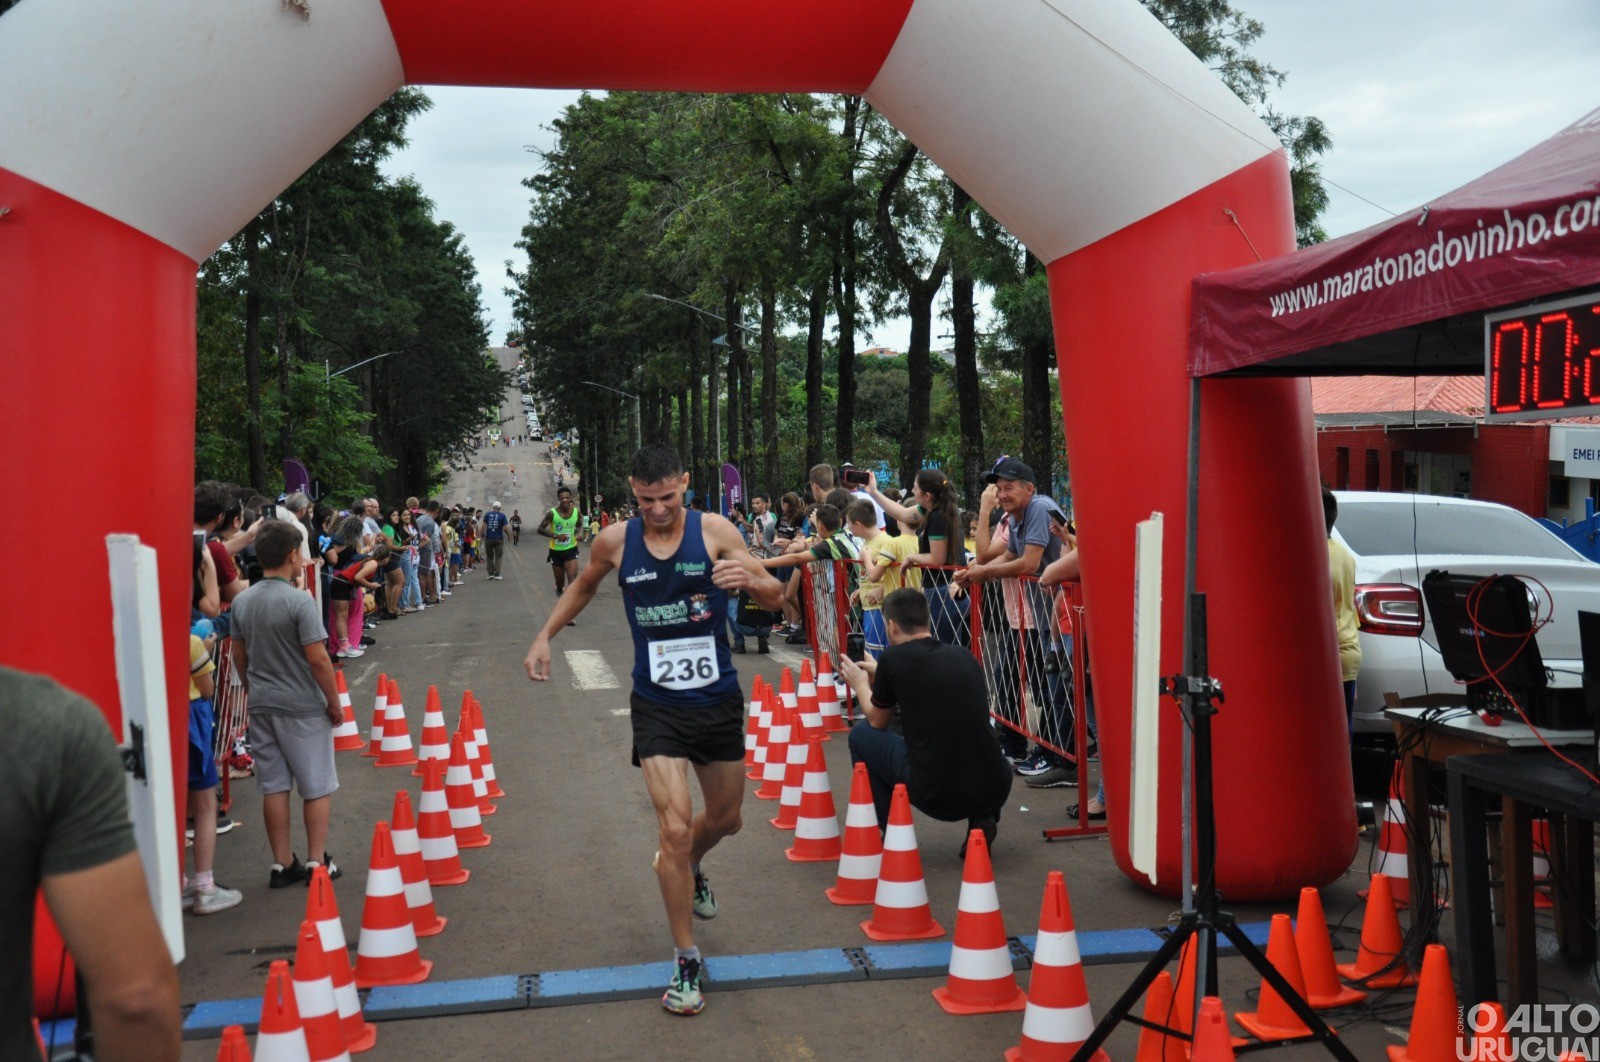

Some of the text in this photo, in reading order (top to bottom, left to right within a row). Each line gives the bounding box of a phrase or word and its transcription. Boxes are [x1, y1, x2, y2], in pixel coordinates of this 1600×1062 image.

[1573, 448, 1594, 460] EMEI
[635, 600, 688, 621] CHAPECÓ
[657, 656, 714, 683] 236
